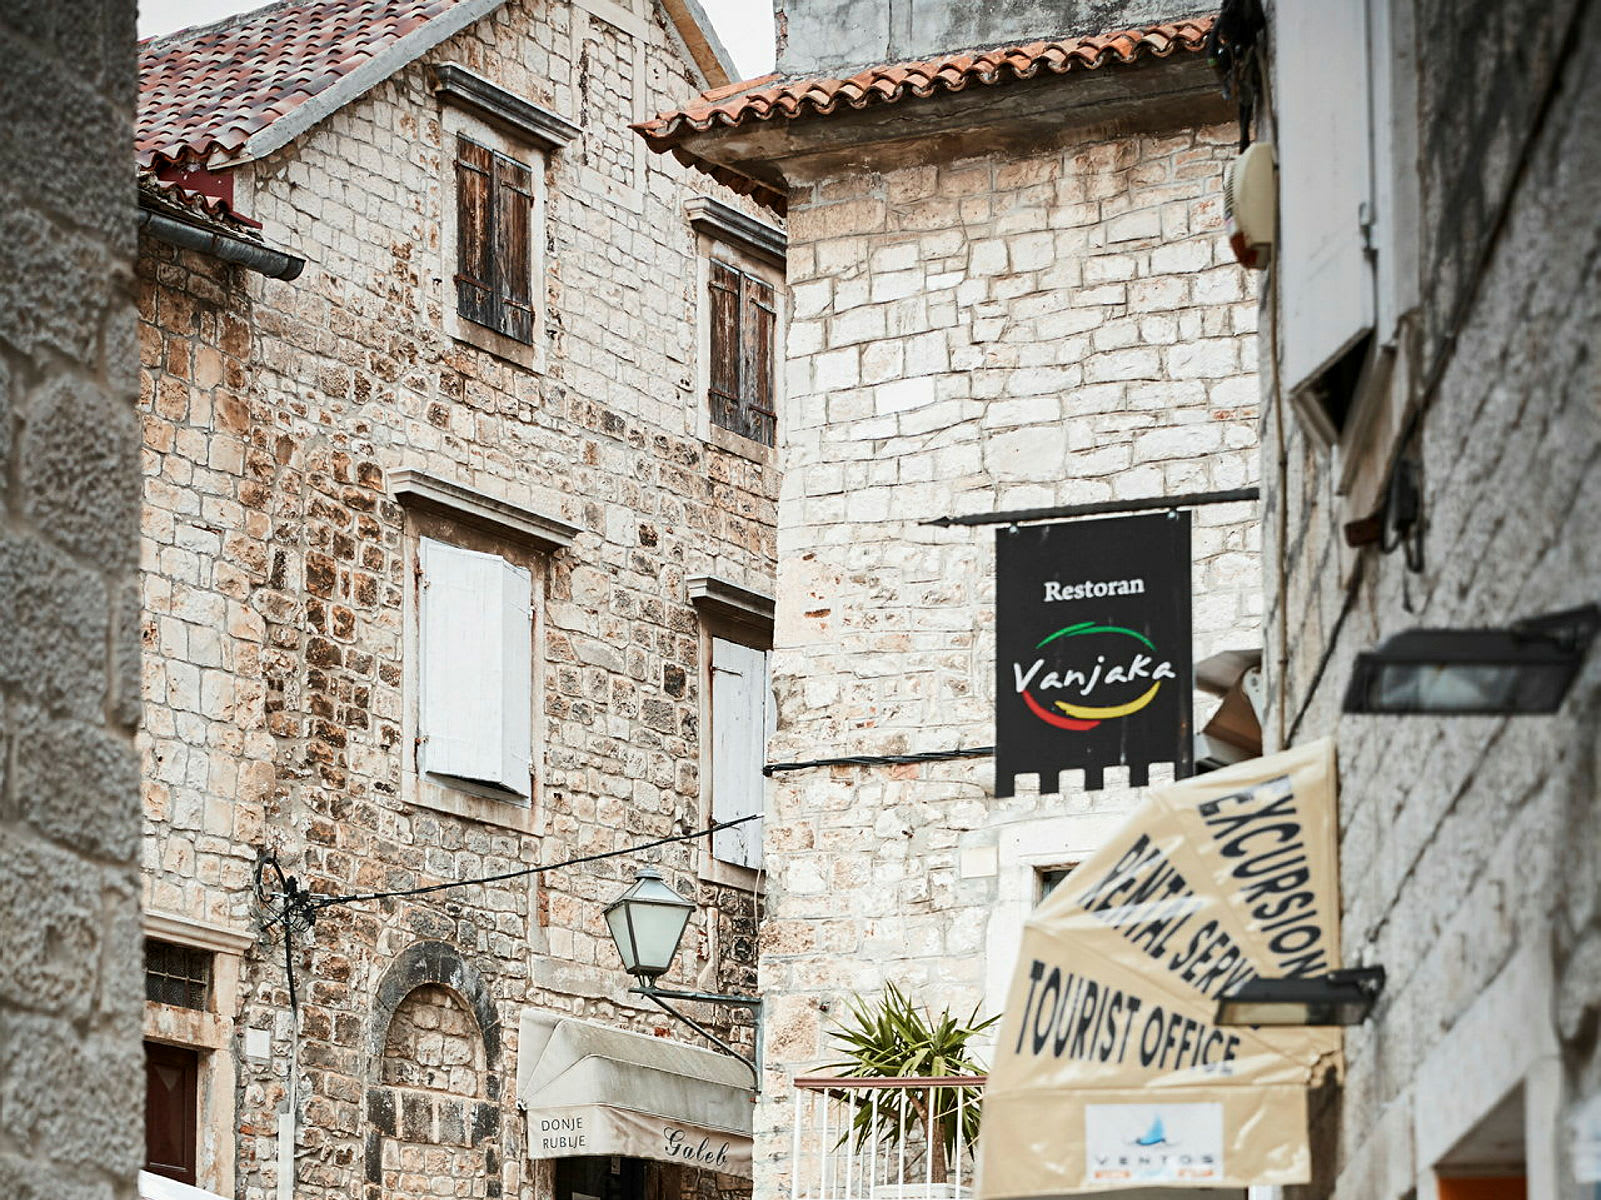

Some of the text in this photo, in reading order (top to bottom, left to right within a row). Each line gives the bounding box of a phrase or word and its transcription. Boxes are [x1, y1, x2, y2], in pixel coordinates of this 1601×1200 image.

[1043, 578, 1145, 602] Restoran
[1013, 653, 1176, 696] Vanjaka
[1015, 959, 1241, 1076] TOURIST OFFICE
[541, 1117, 583, 1132] DONJE
[543, 1135, 586, 1150] RUBLJE
[663, 1126, 730, 1167] Galeb
